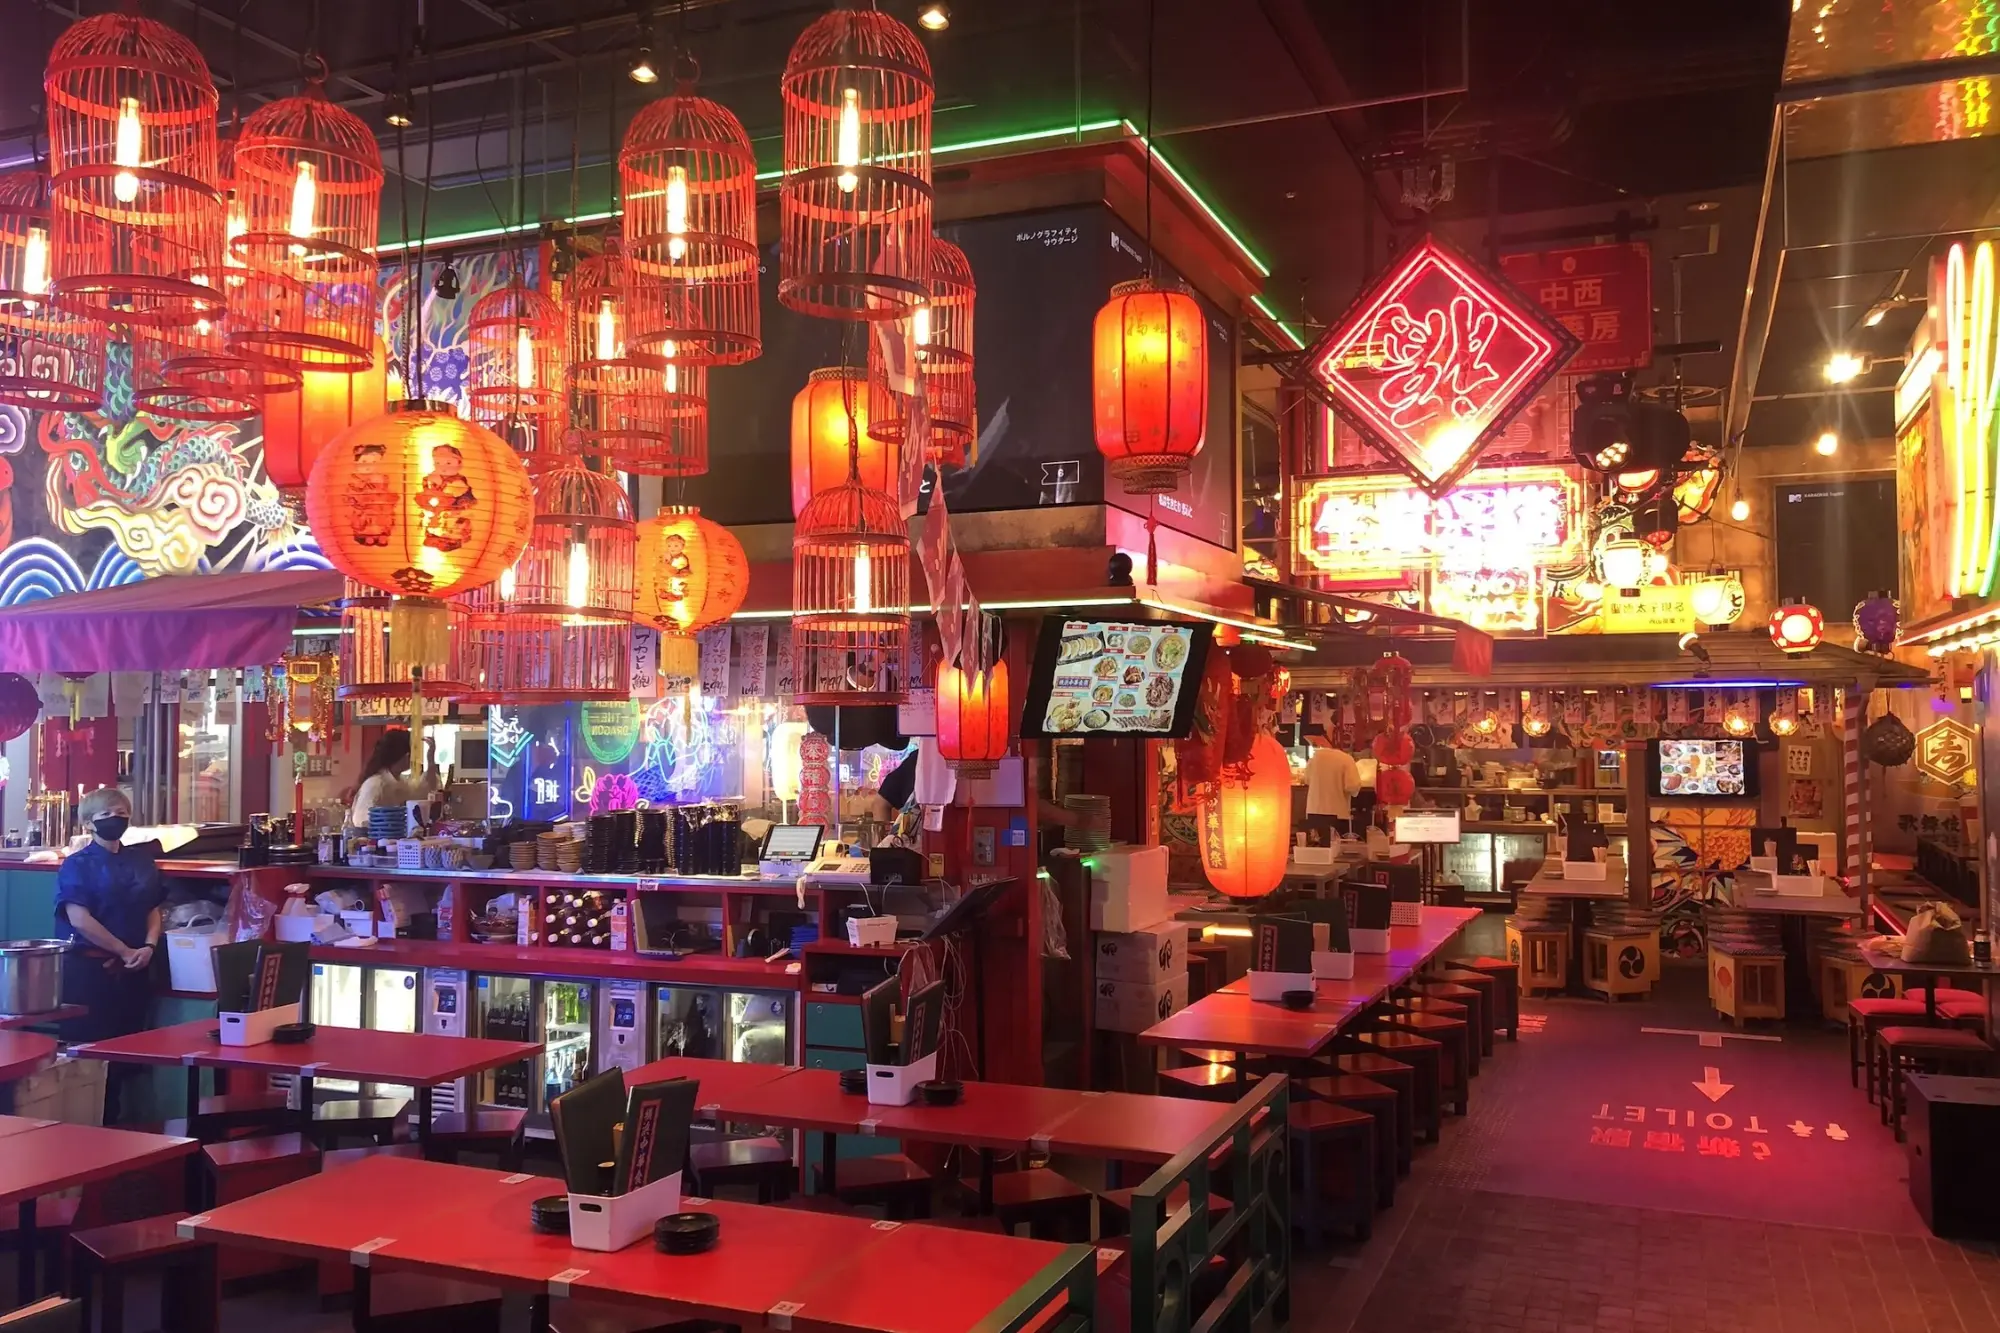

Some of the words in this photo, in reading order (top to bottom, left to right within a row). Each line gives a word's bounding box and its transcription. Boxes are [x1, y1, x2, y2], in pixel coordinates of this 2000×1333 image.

[1016, 227, 1078, 241] ポルノグラフィティ
[1541, 279, 1602, 309] 中西
[1592, 1103, 1768, 1134] TOILET
